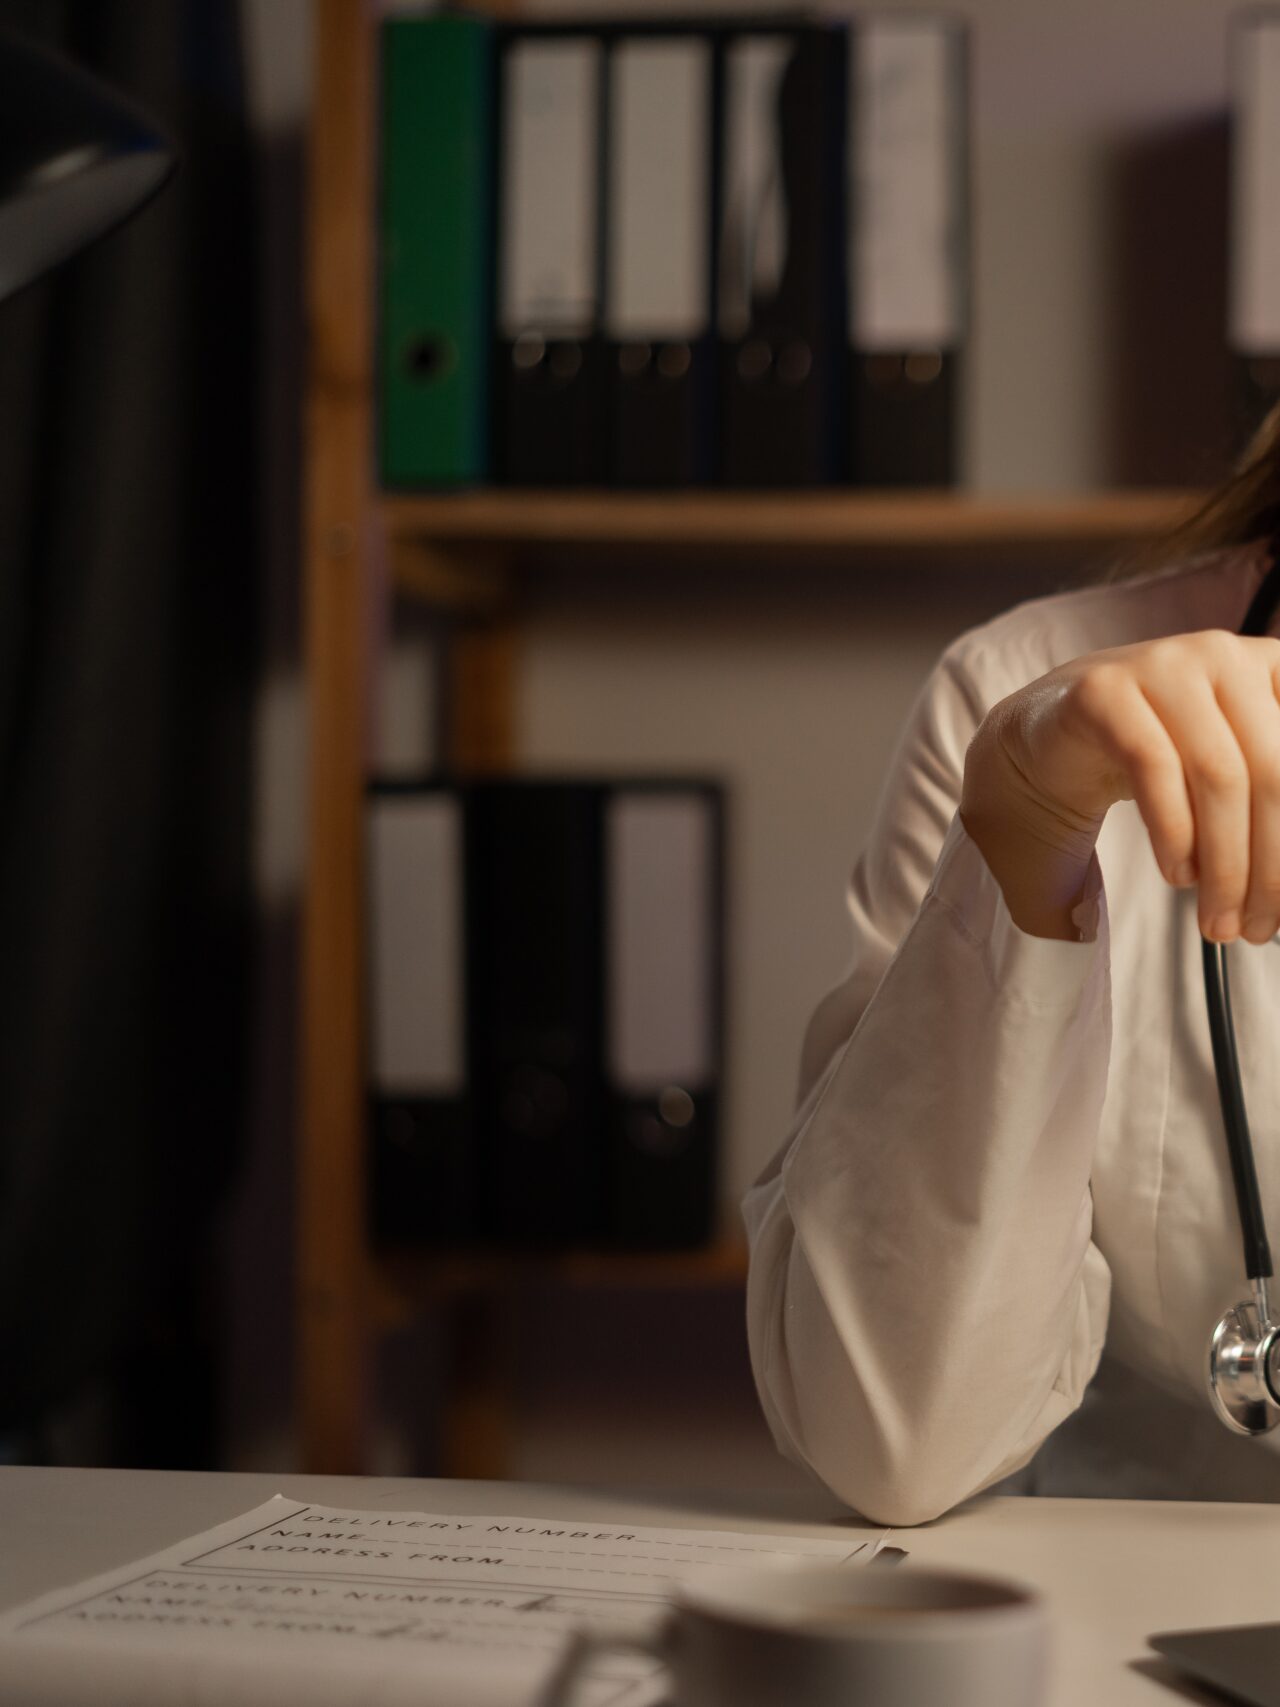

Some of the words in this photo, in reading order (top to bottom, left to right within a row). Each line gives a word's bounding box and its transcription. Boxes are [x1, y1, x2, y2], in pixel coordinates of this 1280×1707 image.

[270, 1530, 366, 1540] NAME
[302, 1515, 472, 1530] DELIVERY
[486, 1526, 637, 1541] NUMBER
[237, 1545, 393, 1558] ADDRESS
[408, 1553, 505, 1565] FROM
